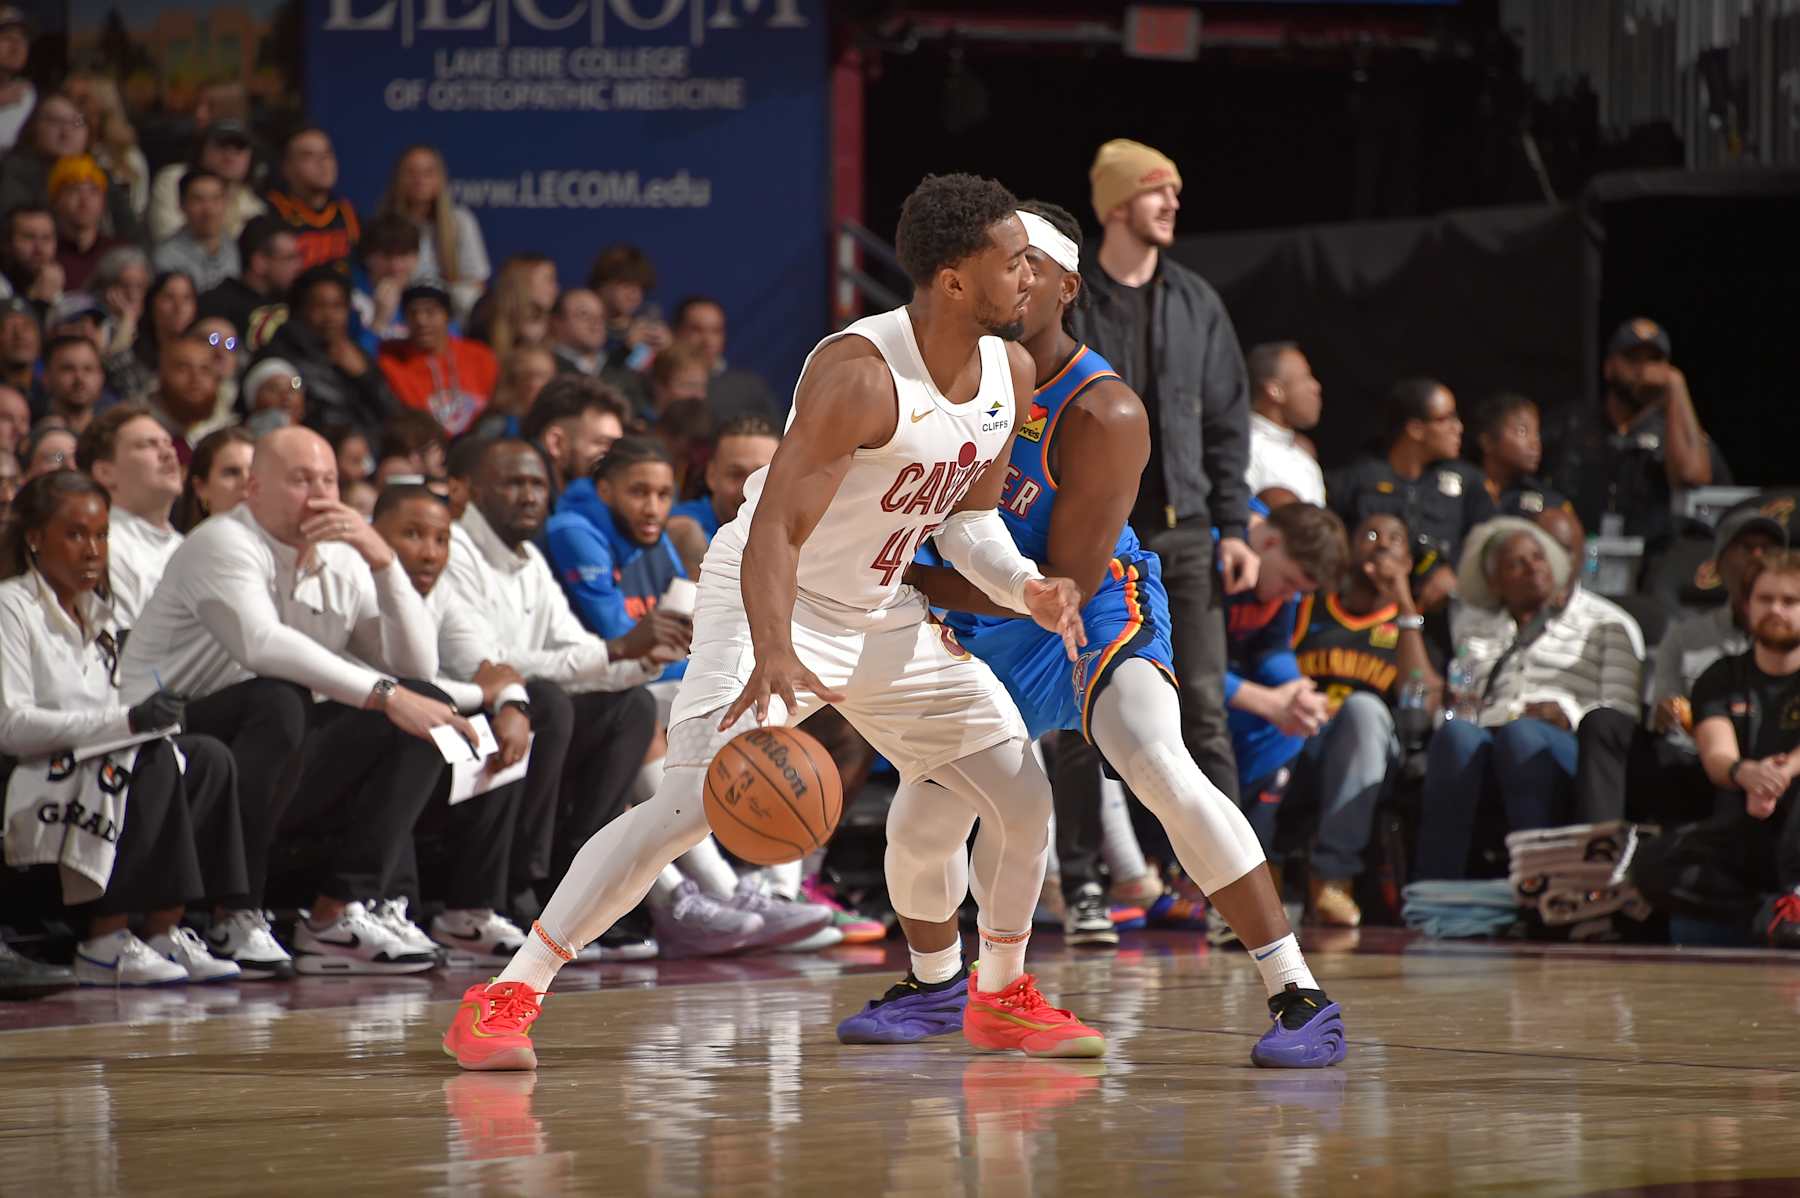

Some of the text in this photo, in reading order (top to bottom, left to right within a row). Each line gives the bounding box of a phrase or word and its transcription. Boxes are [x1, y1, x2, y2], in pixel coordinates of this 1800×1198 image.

[435, 48, 686, 78] LAKE ERIE COLLEGE
[384, 78, 745, 111] OF OSTEOPATHIC MEDICINE
[982, 420, 1009, 432] CLIFFS
[746, 730, 807, 799] Wilson
